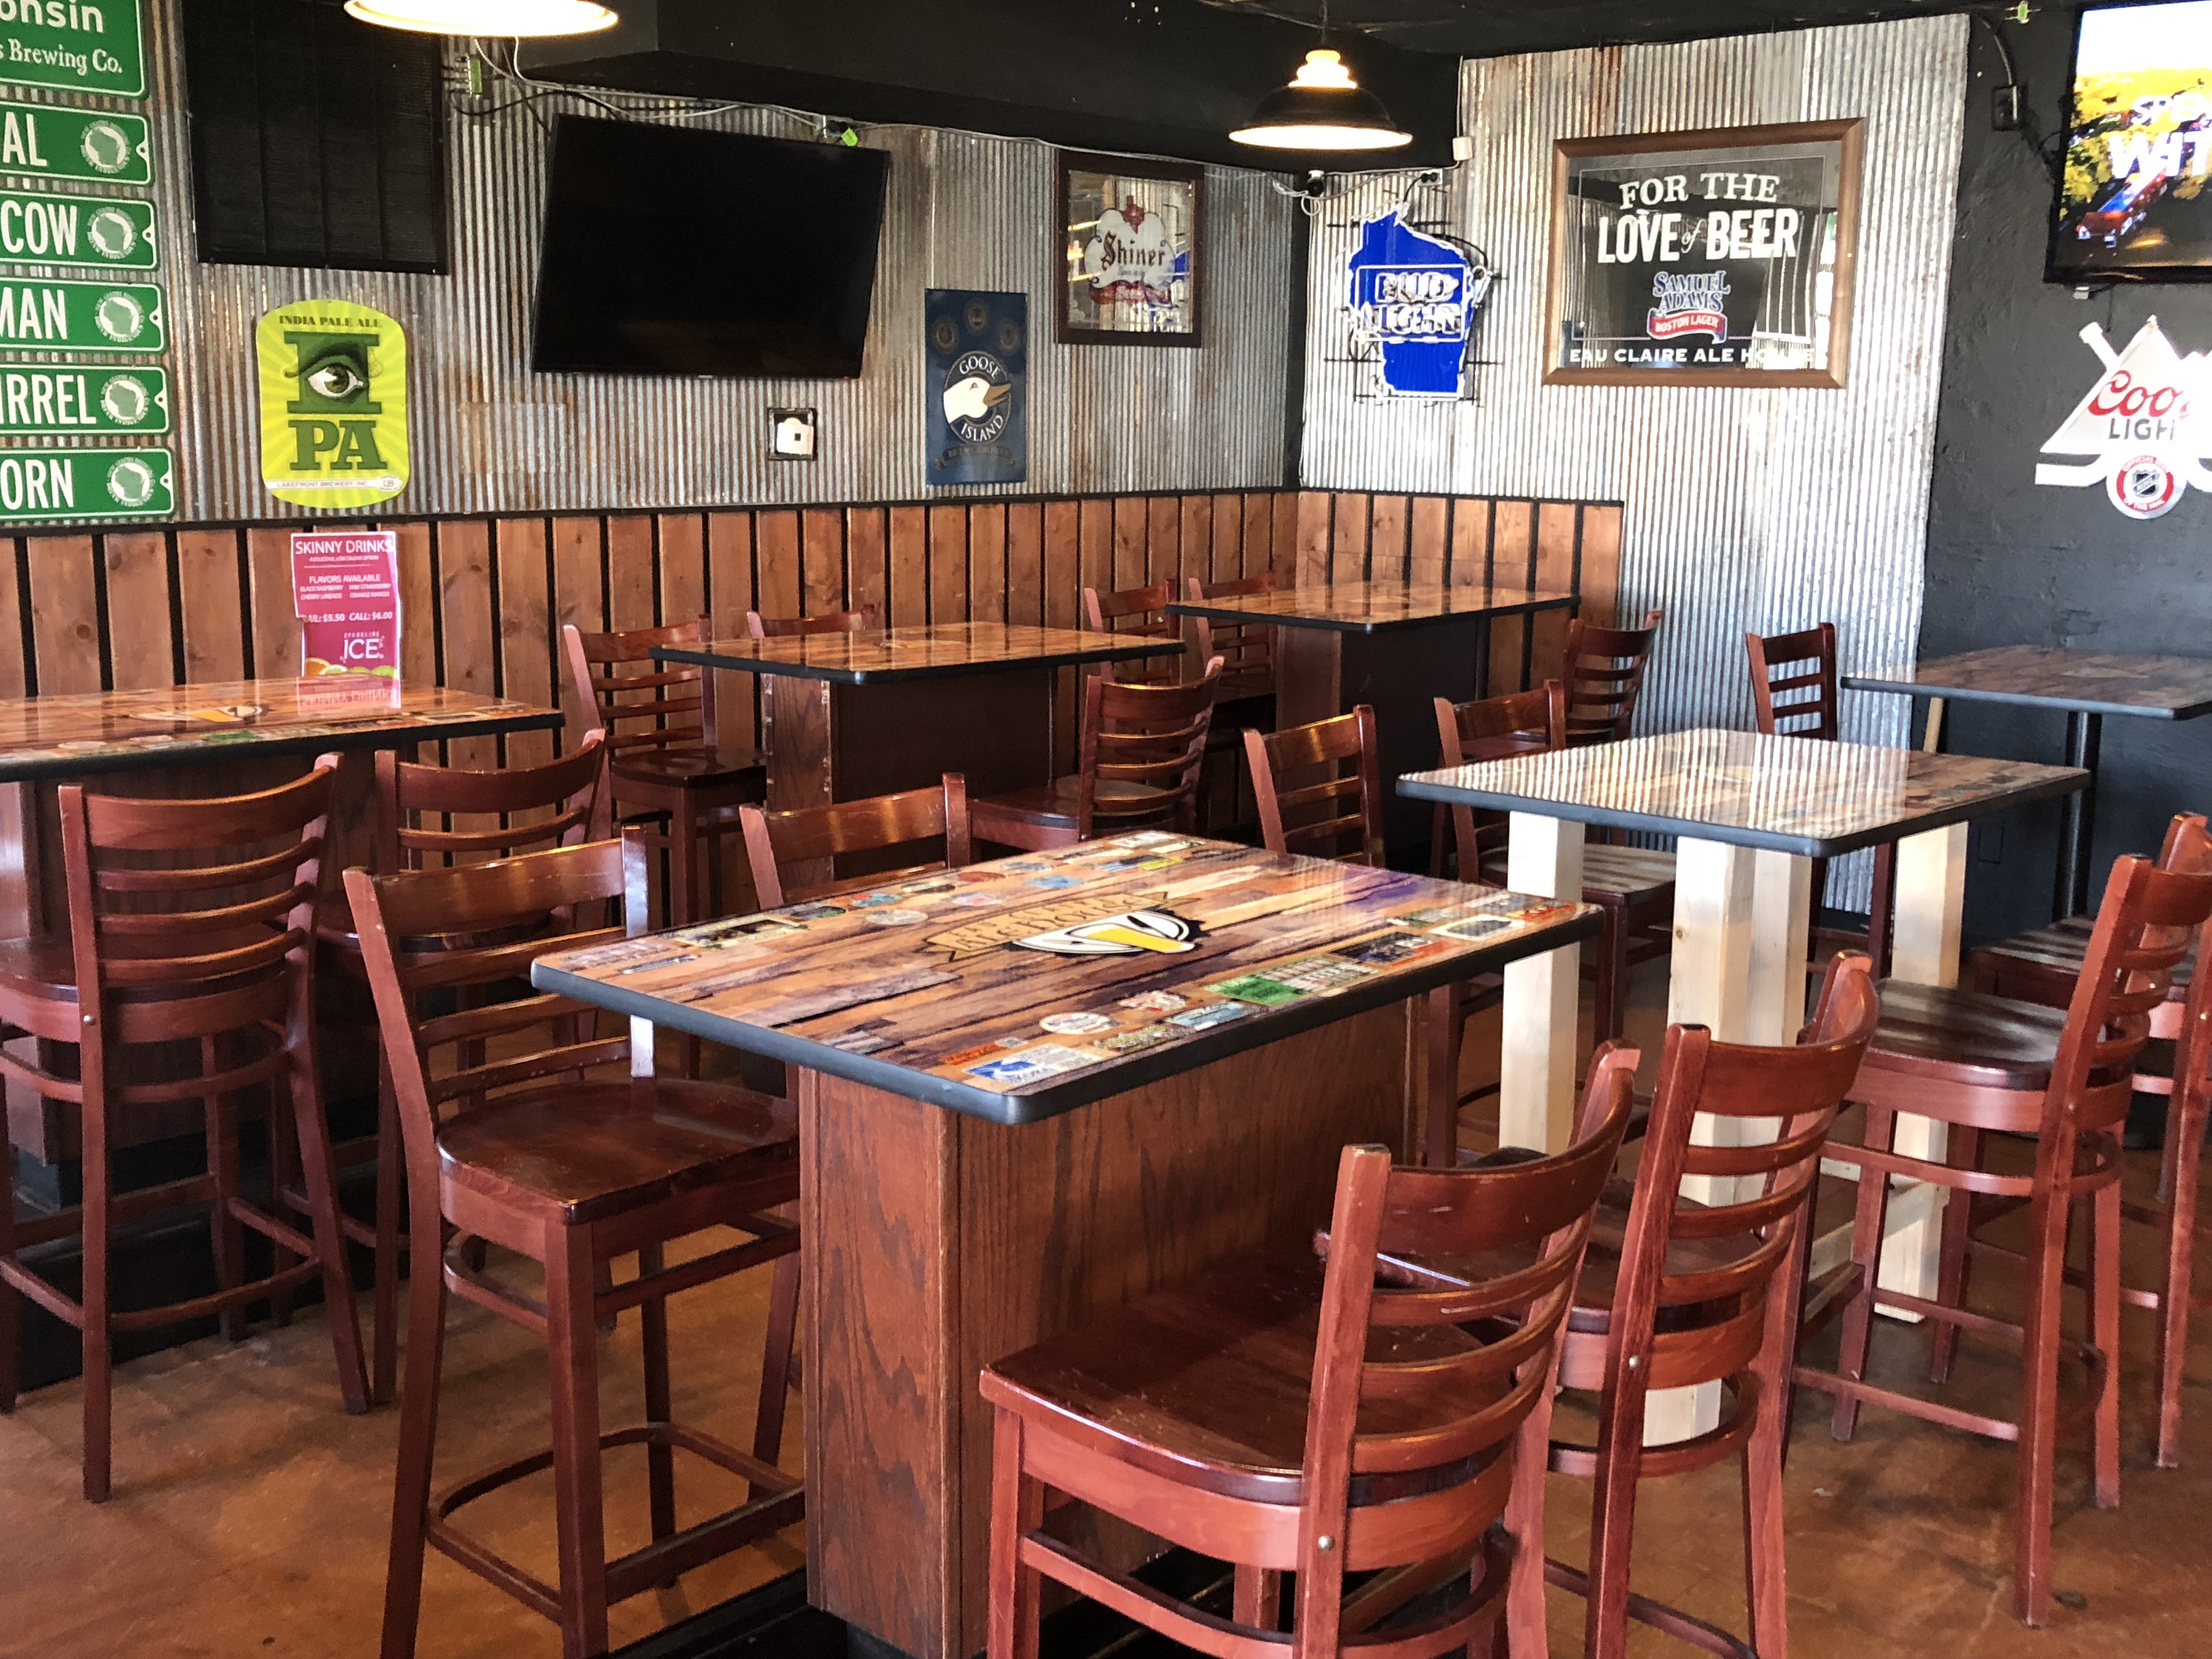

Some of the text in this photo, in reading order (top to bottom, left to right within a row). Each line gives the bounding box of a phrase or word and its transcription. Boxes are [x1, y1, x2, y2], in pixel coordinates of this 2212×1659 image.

[8, 38, 87, 76] Brewing
[92, 48, 122, 73] Co.
[3, 111, 47, 166] AL
[1619, 172, 1780, 210] FOR THE
[1, 200, 77, 256] COW
[1598, 208, 1799, 263] LOVE of BEER
[1101, 230, 1165, 271] Shiner
[1652, 270, 1731, 297] SAMUEL
[1657, 291, 1724, 315] ADAMS
[279, 315, 382, 328] INDIA PALE ALE
[1655, 315, 1719, 332] BOSTON LAGER
[960, 356, 1001, 380] GOOSE
[1570, 349, 1607, 363] EAU
[1614, 348, 1688, 363] CLAIRE
[1694, 348, 1734, 363] ALE
[961, 414, 1004, 442] ISLAND
[288, 420, 387, 471] PA
[2, 459, 74, 510] ORN
[296, 539, 394, 554] SKINNY DRINKS
[309, 574, 380, 584] FLAVORS AVAILABLE
[343, 639, 379, 659] ICE
